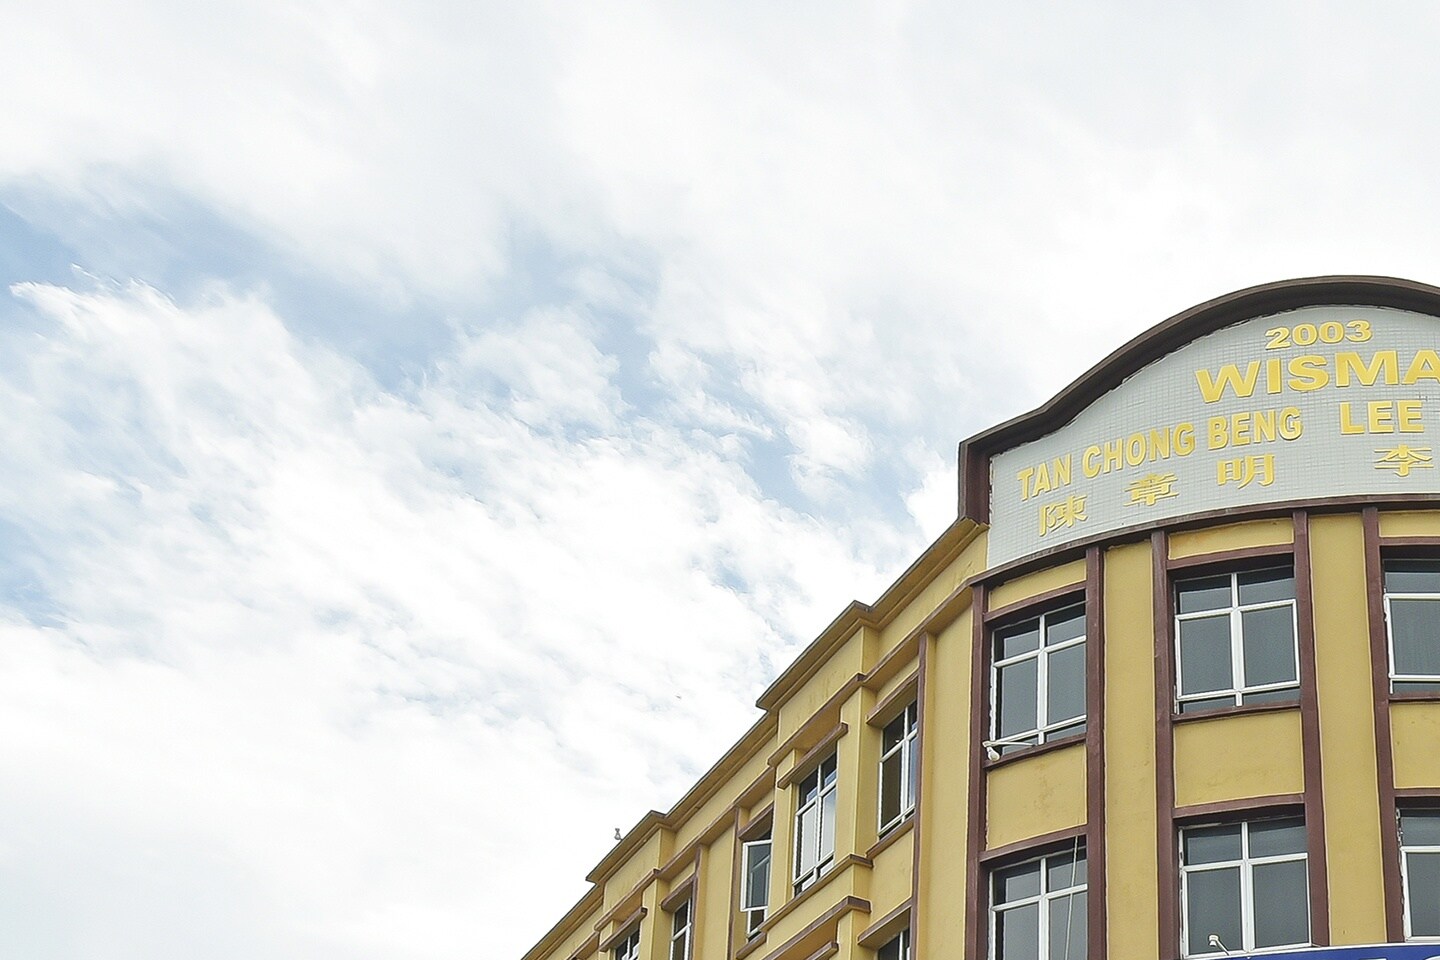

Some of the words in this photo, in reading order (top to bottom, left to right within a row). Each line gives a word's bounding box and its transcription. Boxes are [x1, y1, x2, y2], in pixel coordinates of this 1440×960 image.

[1264, 320, 1373, 350] 2003
[1017, 454, 1072, 501] TAN
[1081, 422, 1196, 478] CHONG
[1207, 406, 1303, 450] BENG
[1339, 400, 1425, 435] LEE
